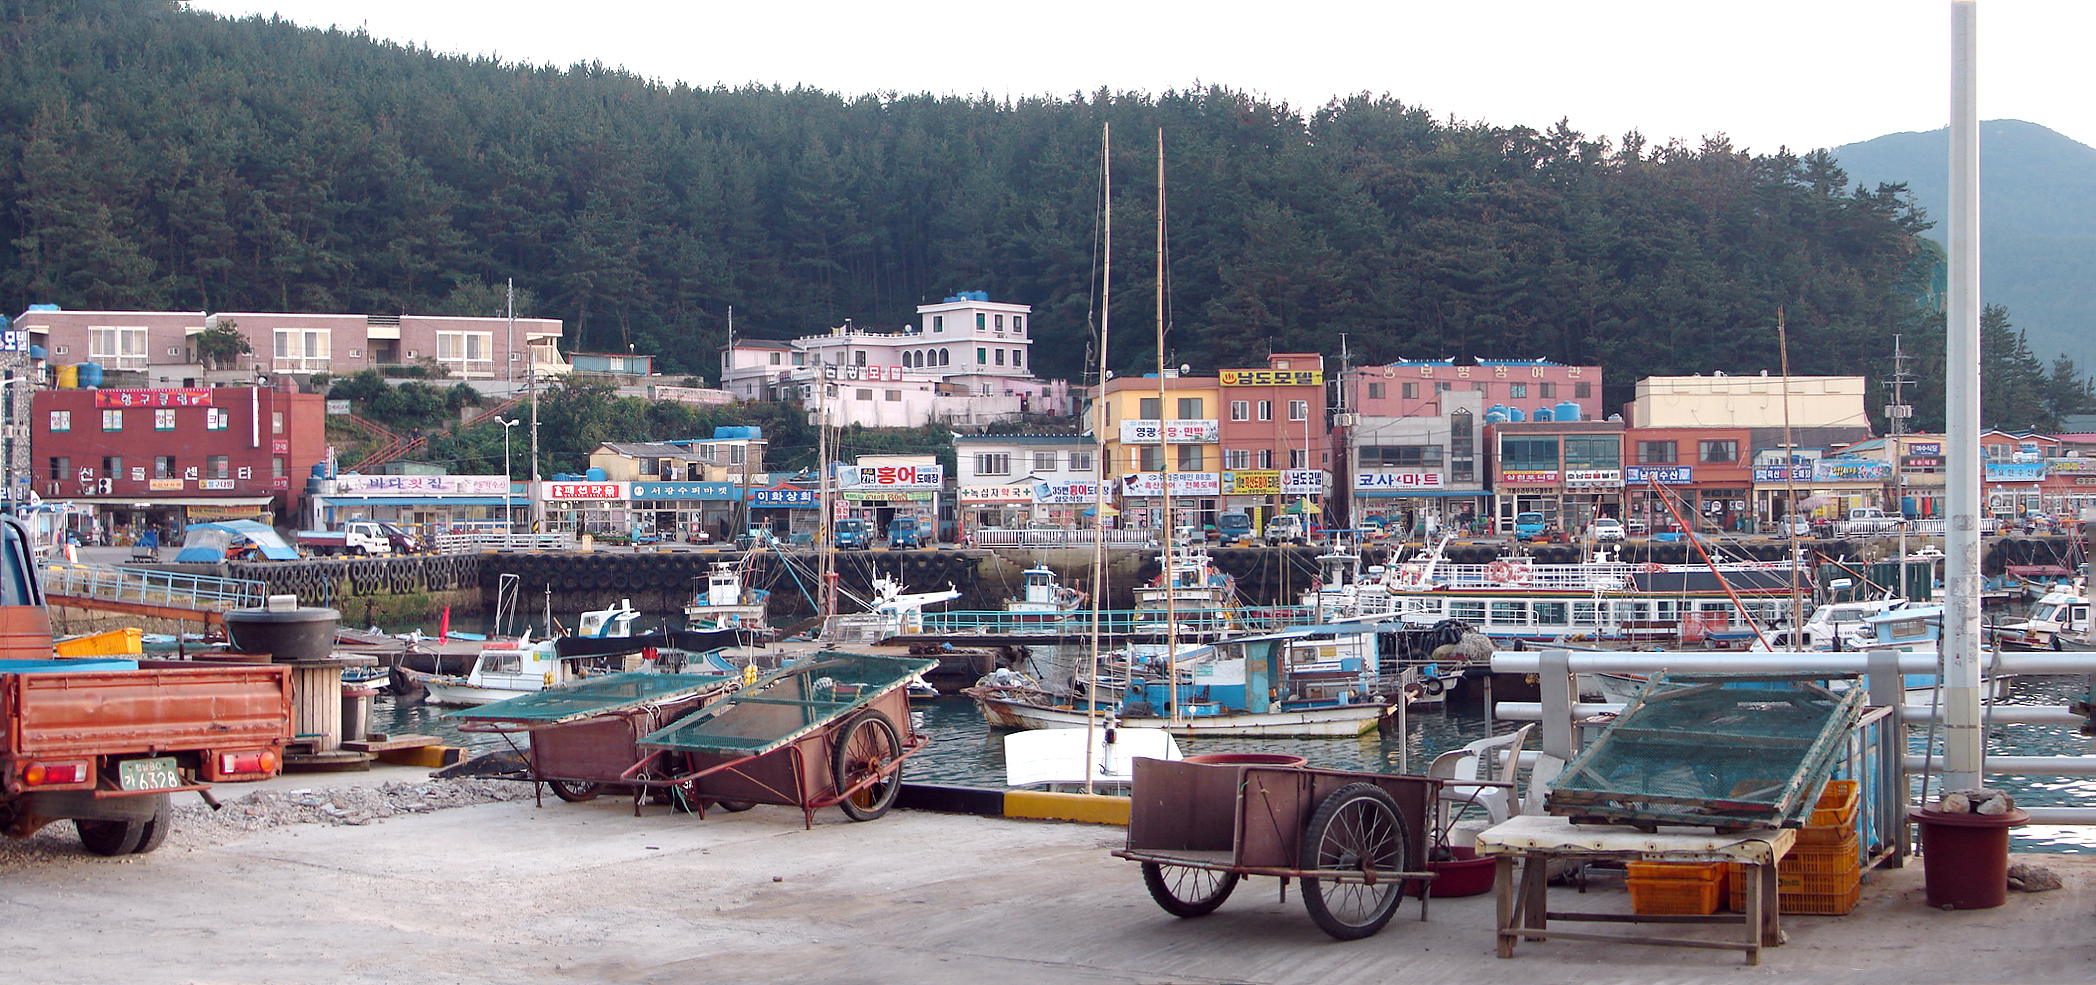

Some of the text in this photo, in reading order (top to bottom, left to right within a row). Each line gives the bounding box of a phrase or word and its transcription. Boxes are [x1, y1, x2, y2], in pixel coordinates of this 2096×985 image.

[1238, 372, 1312, 385] 남도모텔
[877, 466, 916, 484] 홍어
[1359, 474, 1439, 486] 코사마트
[369, 477, 442, 489] 바다횟집
[650, 486, 728, 495] 서광수퍼마켓
[757, 491, 812, 501] 이화상회
[970, 488, 1021, 498] 녹십자약국
